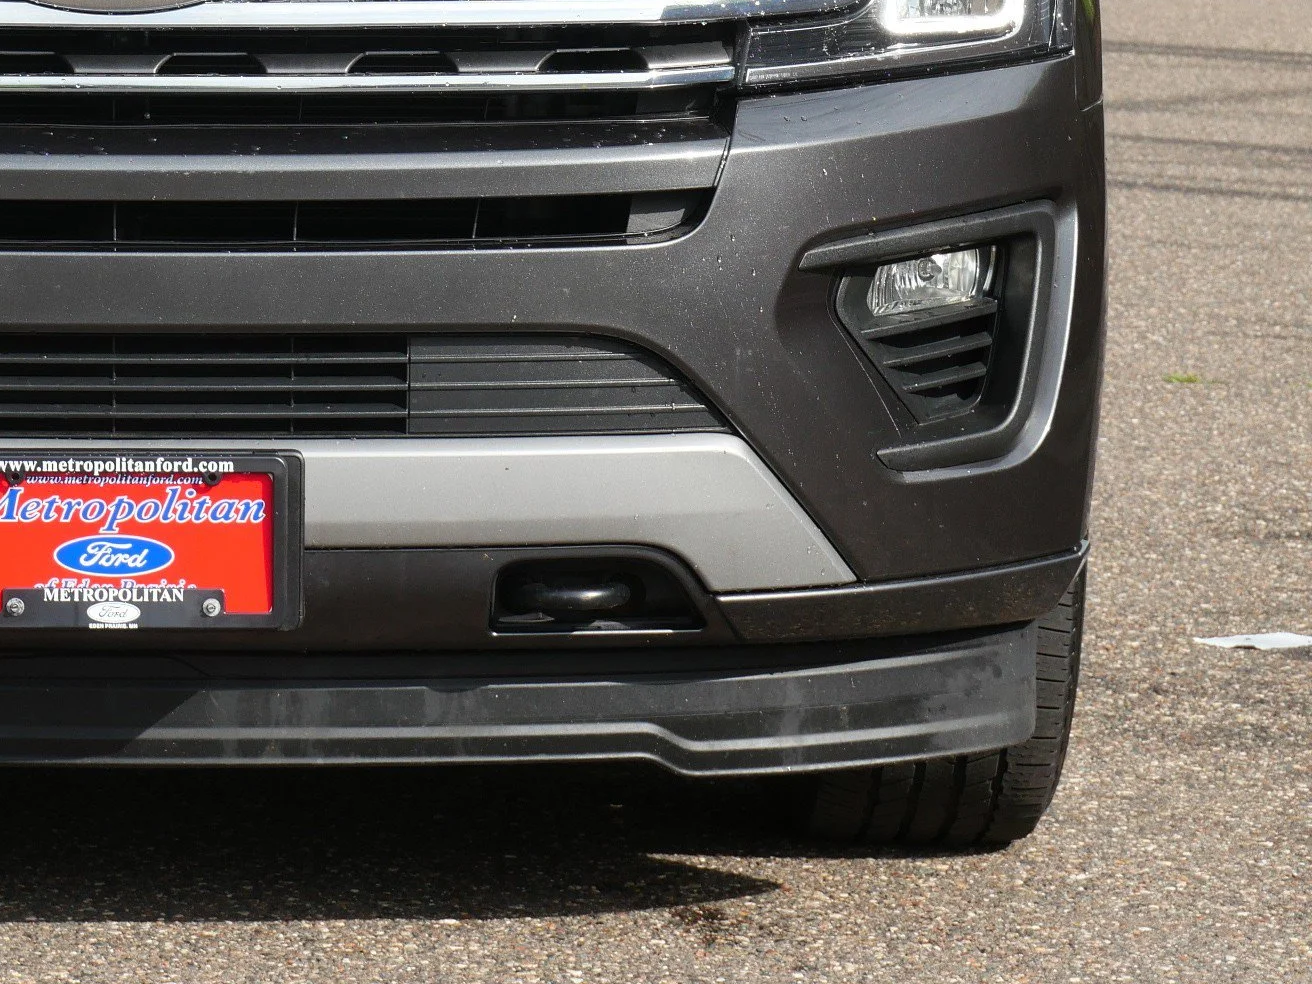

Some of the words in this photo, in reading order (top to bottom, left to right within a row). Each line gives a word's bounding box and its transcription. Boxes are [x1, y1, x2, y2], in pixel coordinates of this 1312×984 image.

[26, 473, 203, 487] www.metropolitanford.com
[79, 541, 149, 567] Ford
[43, 588, 185, 602] METROPOLITAN
[98, 605, 128, 618] Ford
